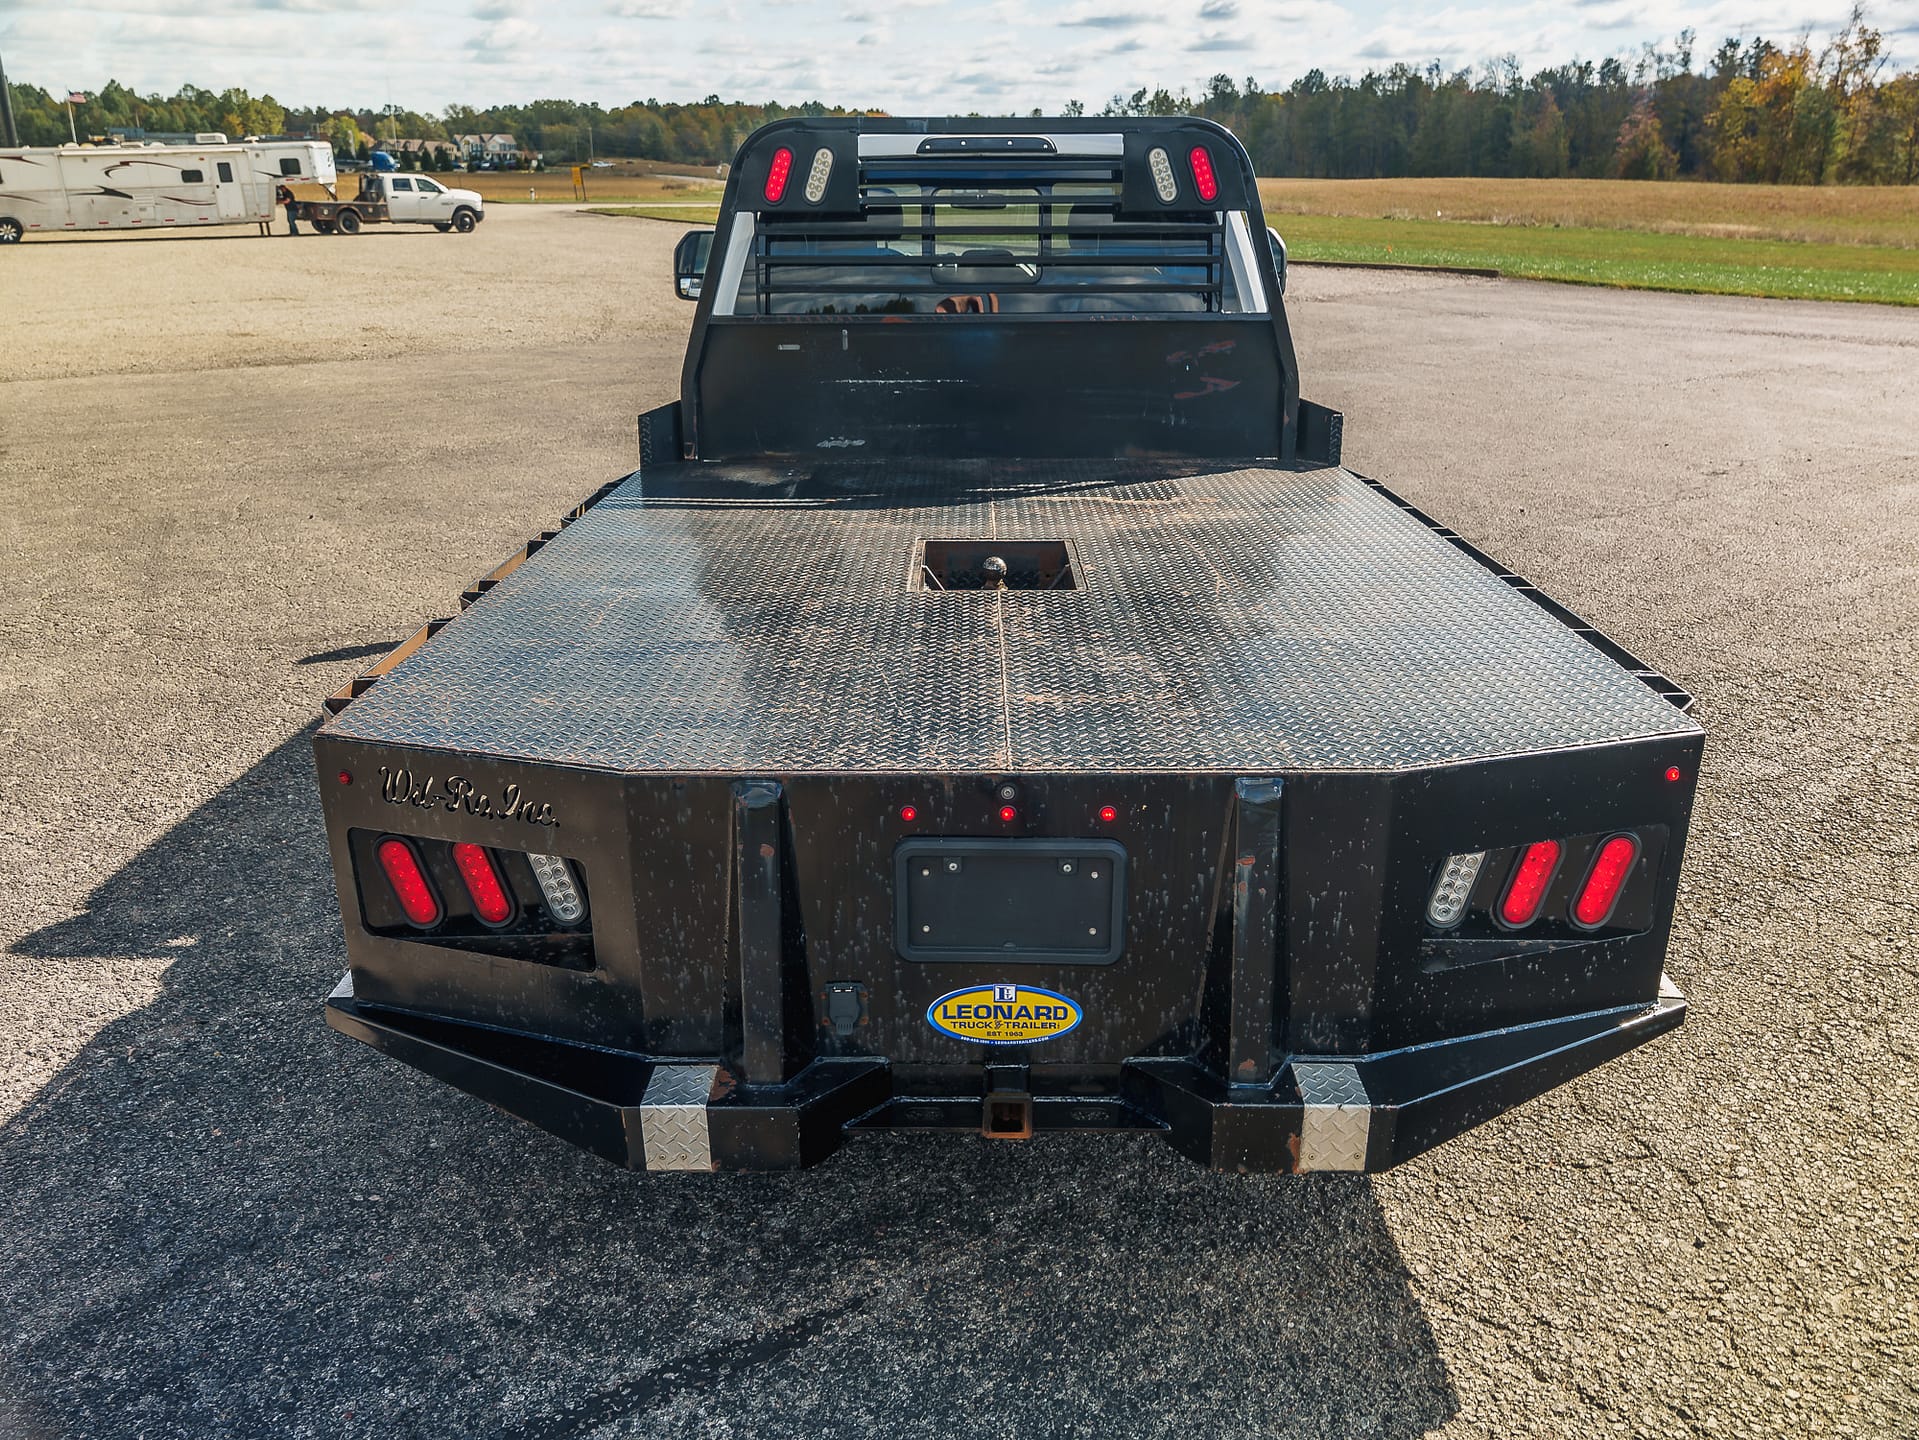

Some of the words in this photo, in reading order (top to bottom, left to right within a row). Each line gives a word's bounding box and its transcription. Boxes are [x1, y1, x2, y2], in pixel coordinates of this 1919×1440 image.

[942, 1004, 1068, 1021] LEONARD
[950, 1021, 992, 1029] TRUCK
[1003, 1021, 1057, 1030] TRAILER
